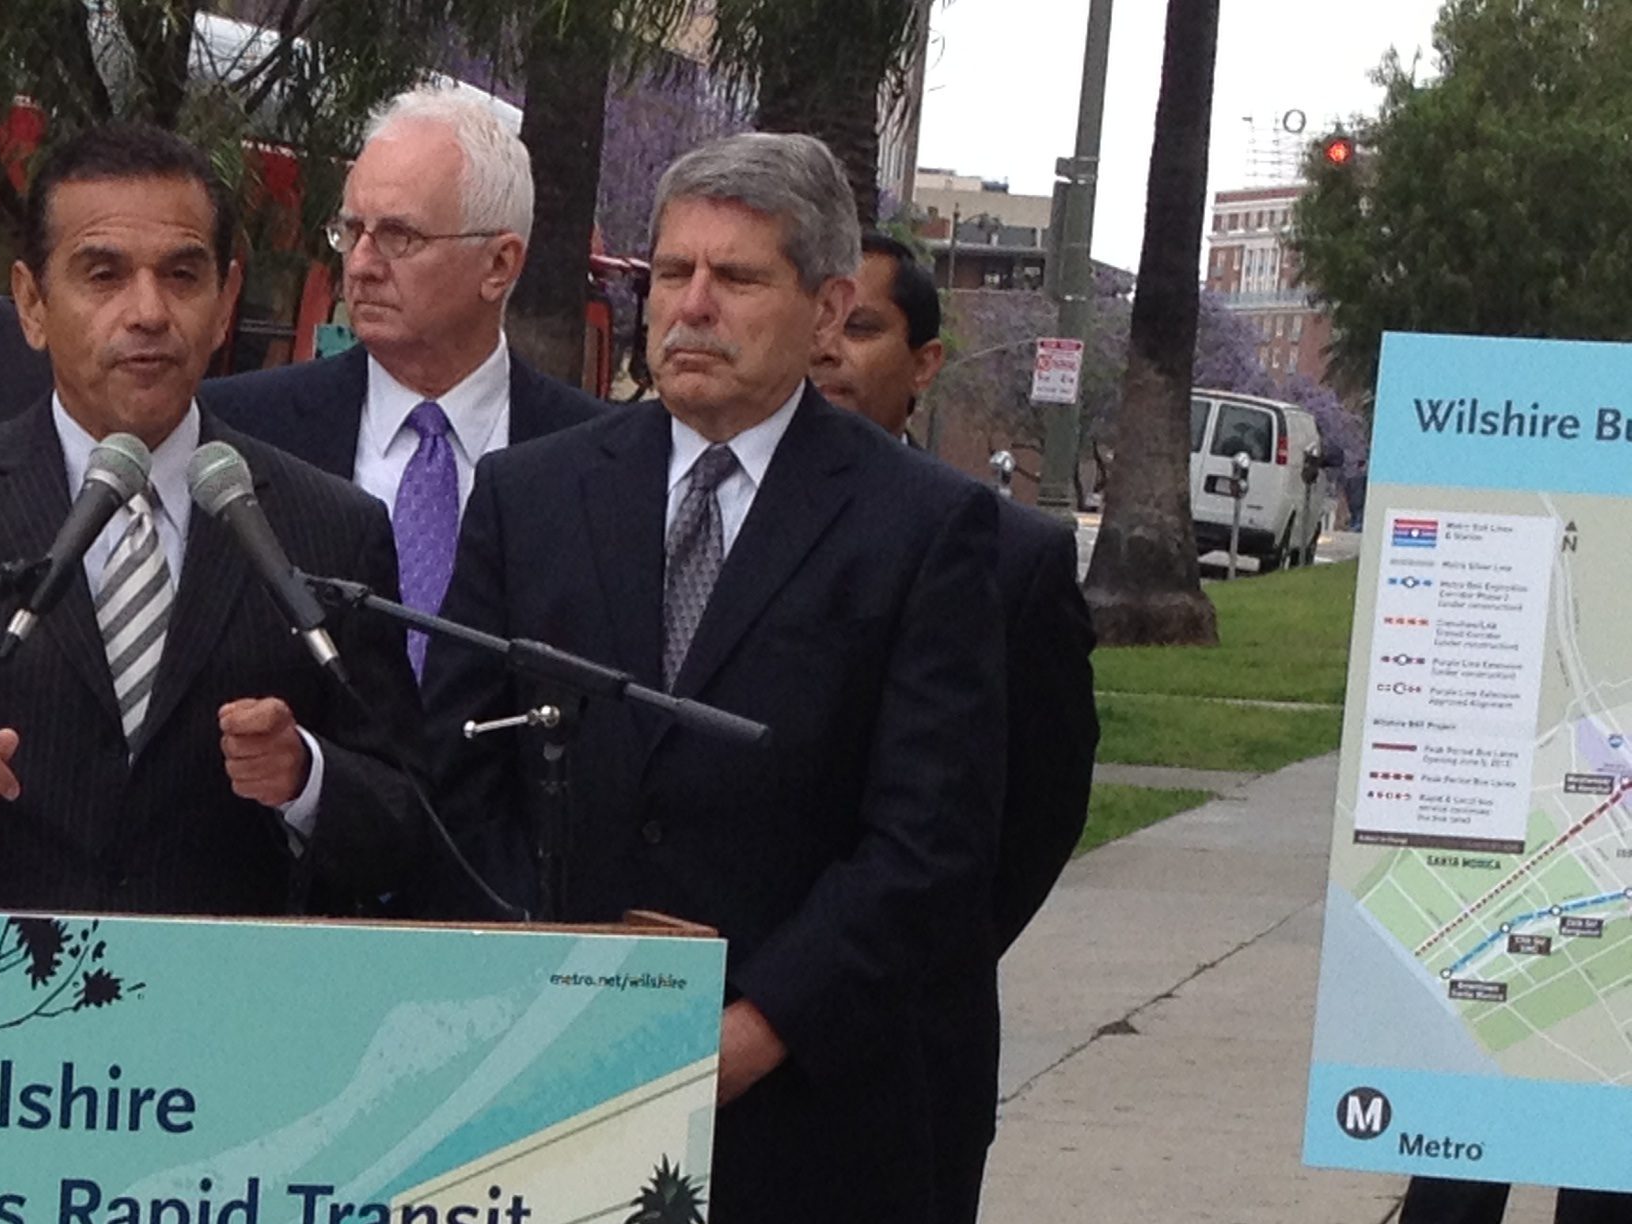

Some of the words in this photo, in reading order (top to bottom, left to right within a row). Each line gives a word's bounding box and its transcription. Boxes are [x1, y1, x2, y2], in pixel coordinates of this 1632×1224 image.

[1413, 398, 1580, 440] Wilshire
[1561, 537, 1577, 553] N
[1398, 1132, 1483, 1162] Metro
